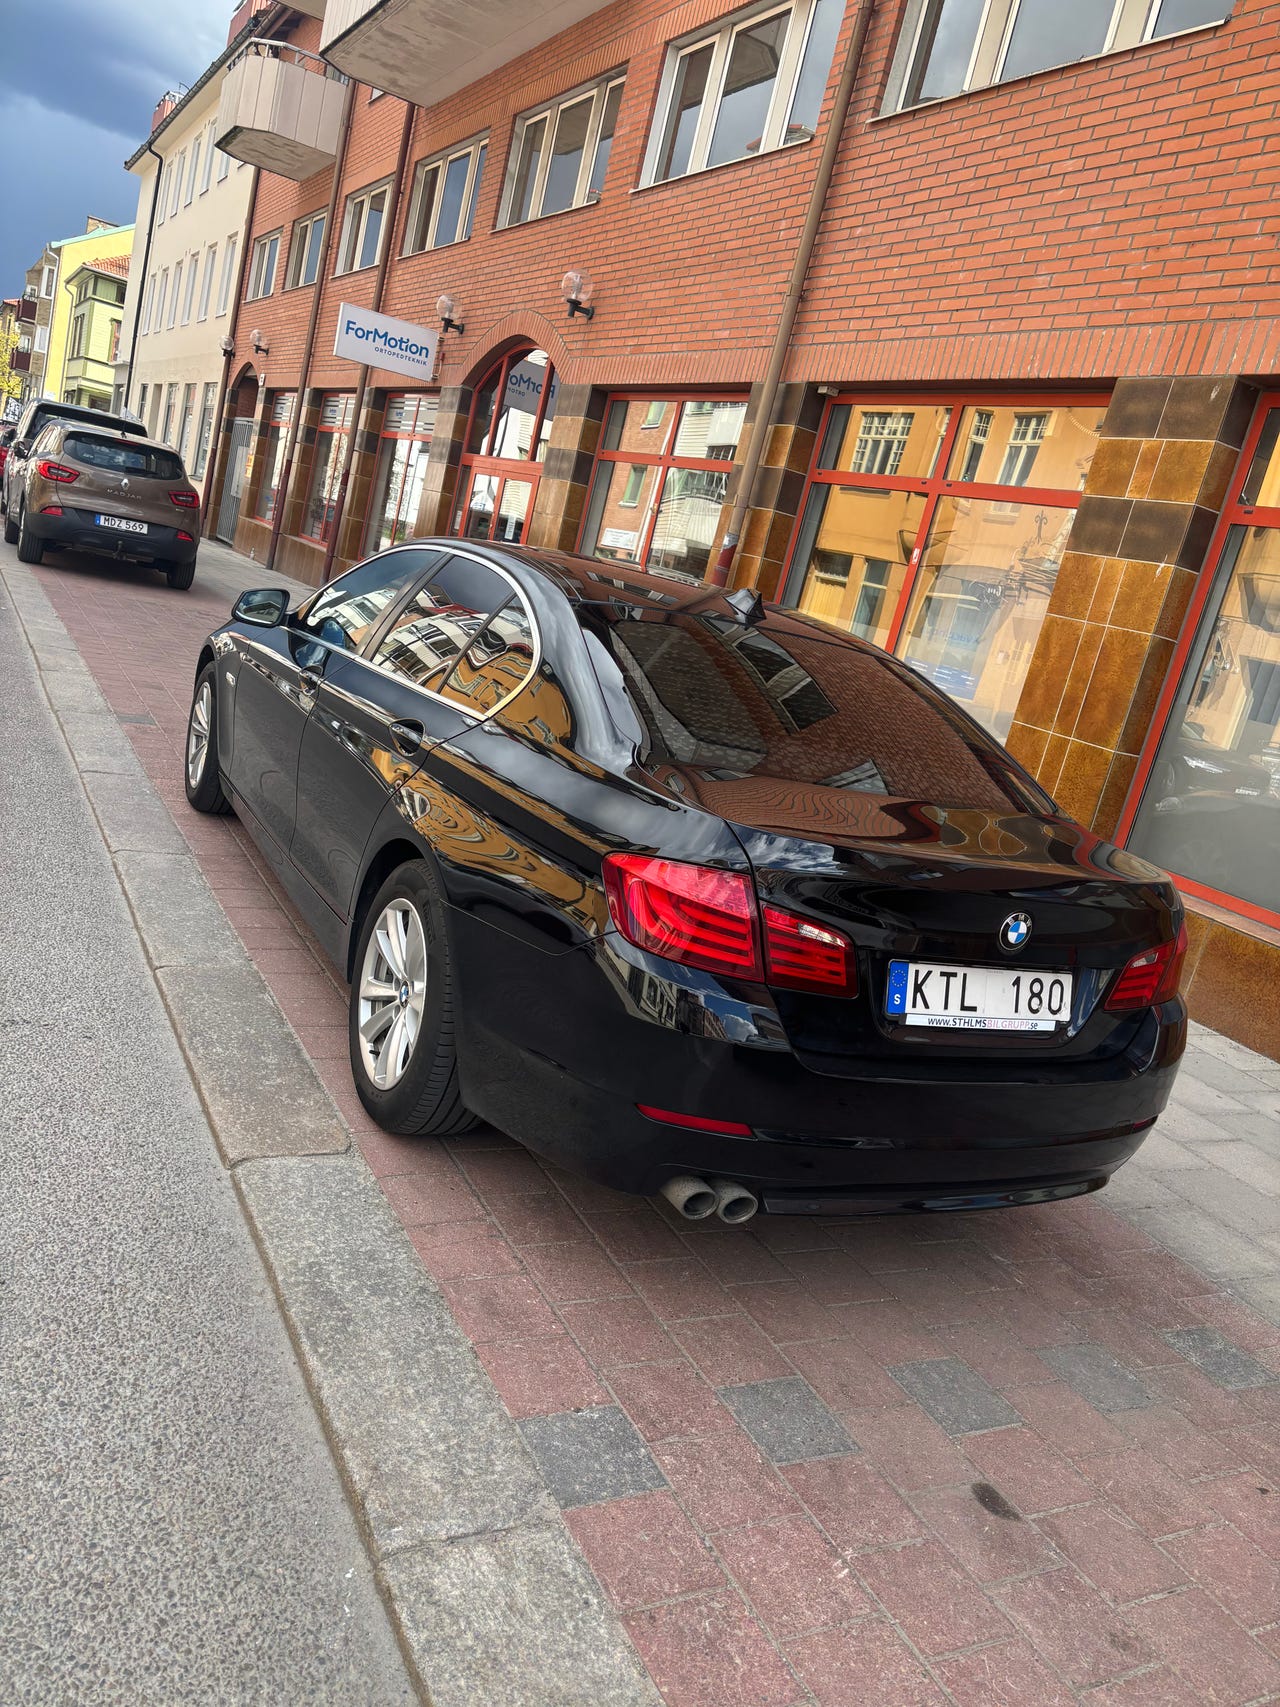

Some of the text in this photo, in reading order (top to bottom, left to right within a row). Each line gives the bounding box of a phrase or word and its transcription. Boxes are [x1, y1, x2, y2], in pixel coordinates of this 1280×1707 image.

[345, 320, 429, 358] ForMotion
[374, 346, 428, 366] ORTOPEDTEKNIK
[103, 516, 144, 532] MDZ 569
[893, 993, 901, 1005] S
[911, 969, 1065, 1016] KTL 180
